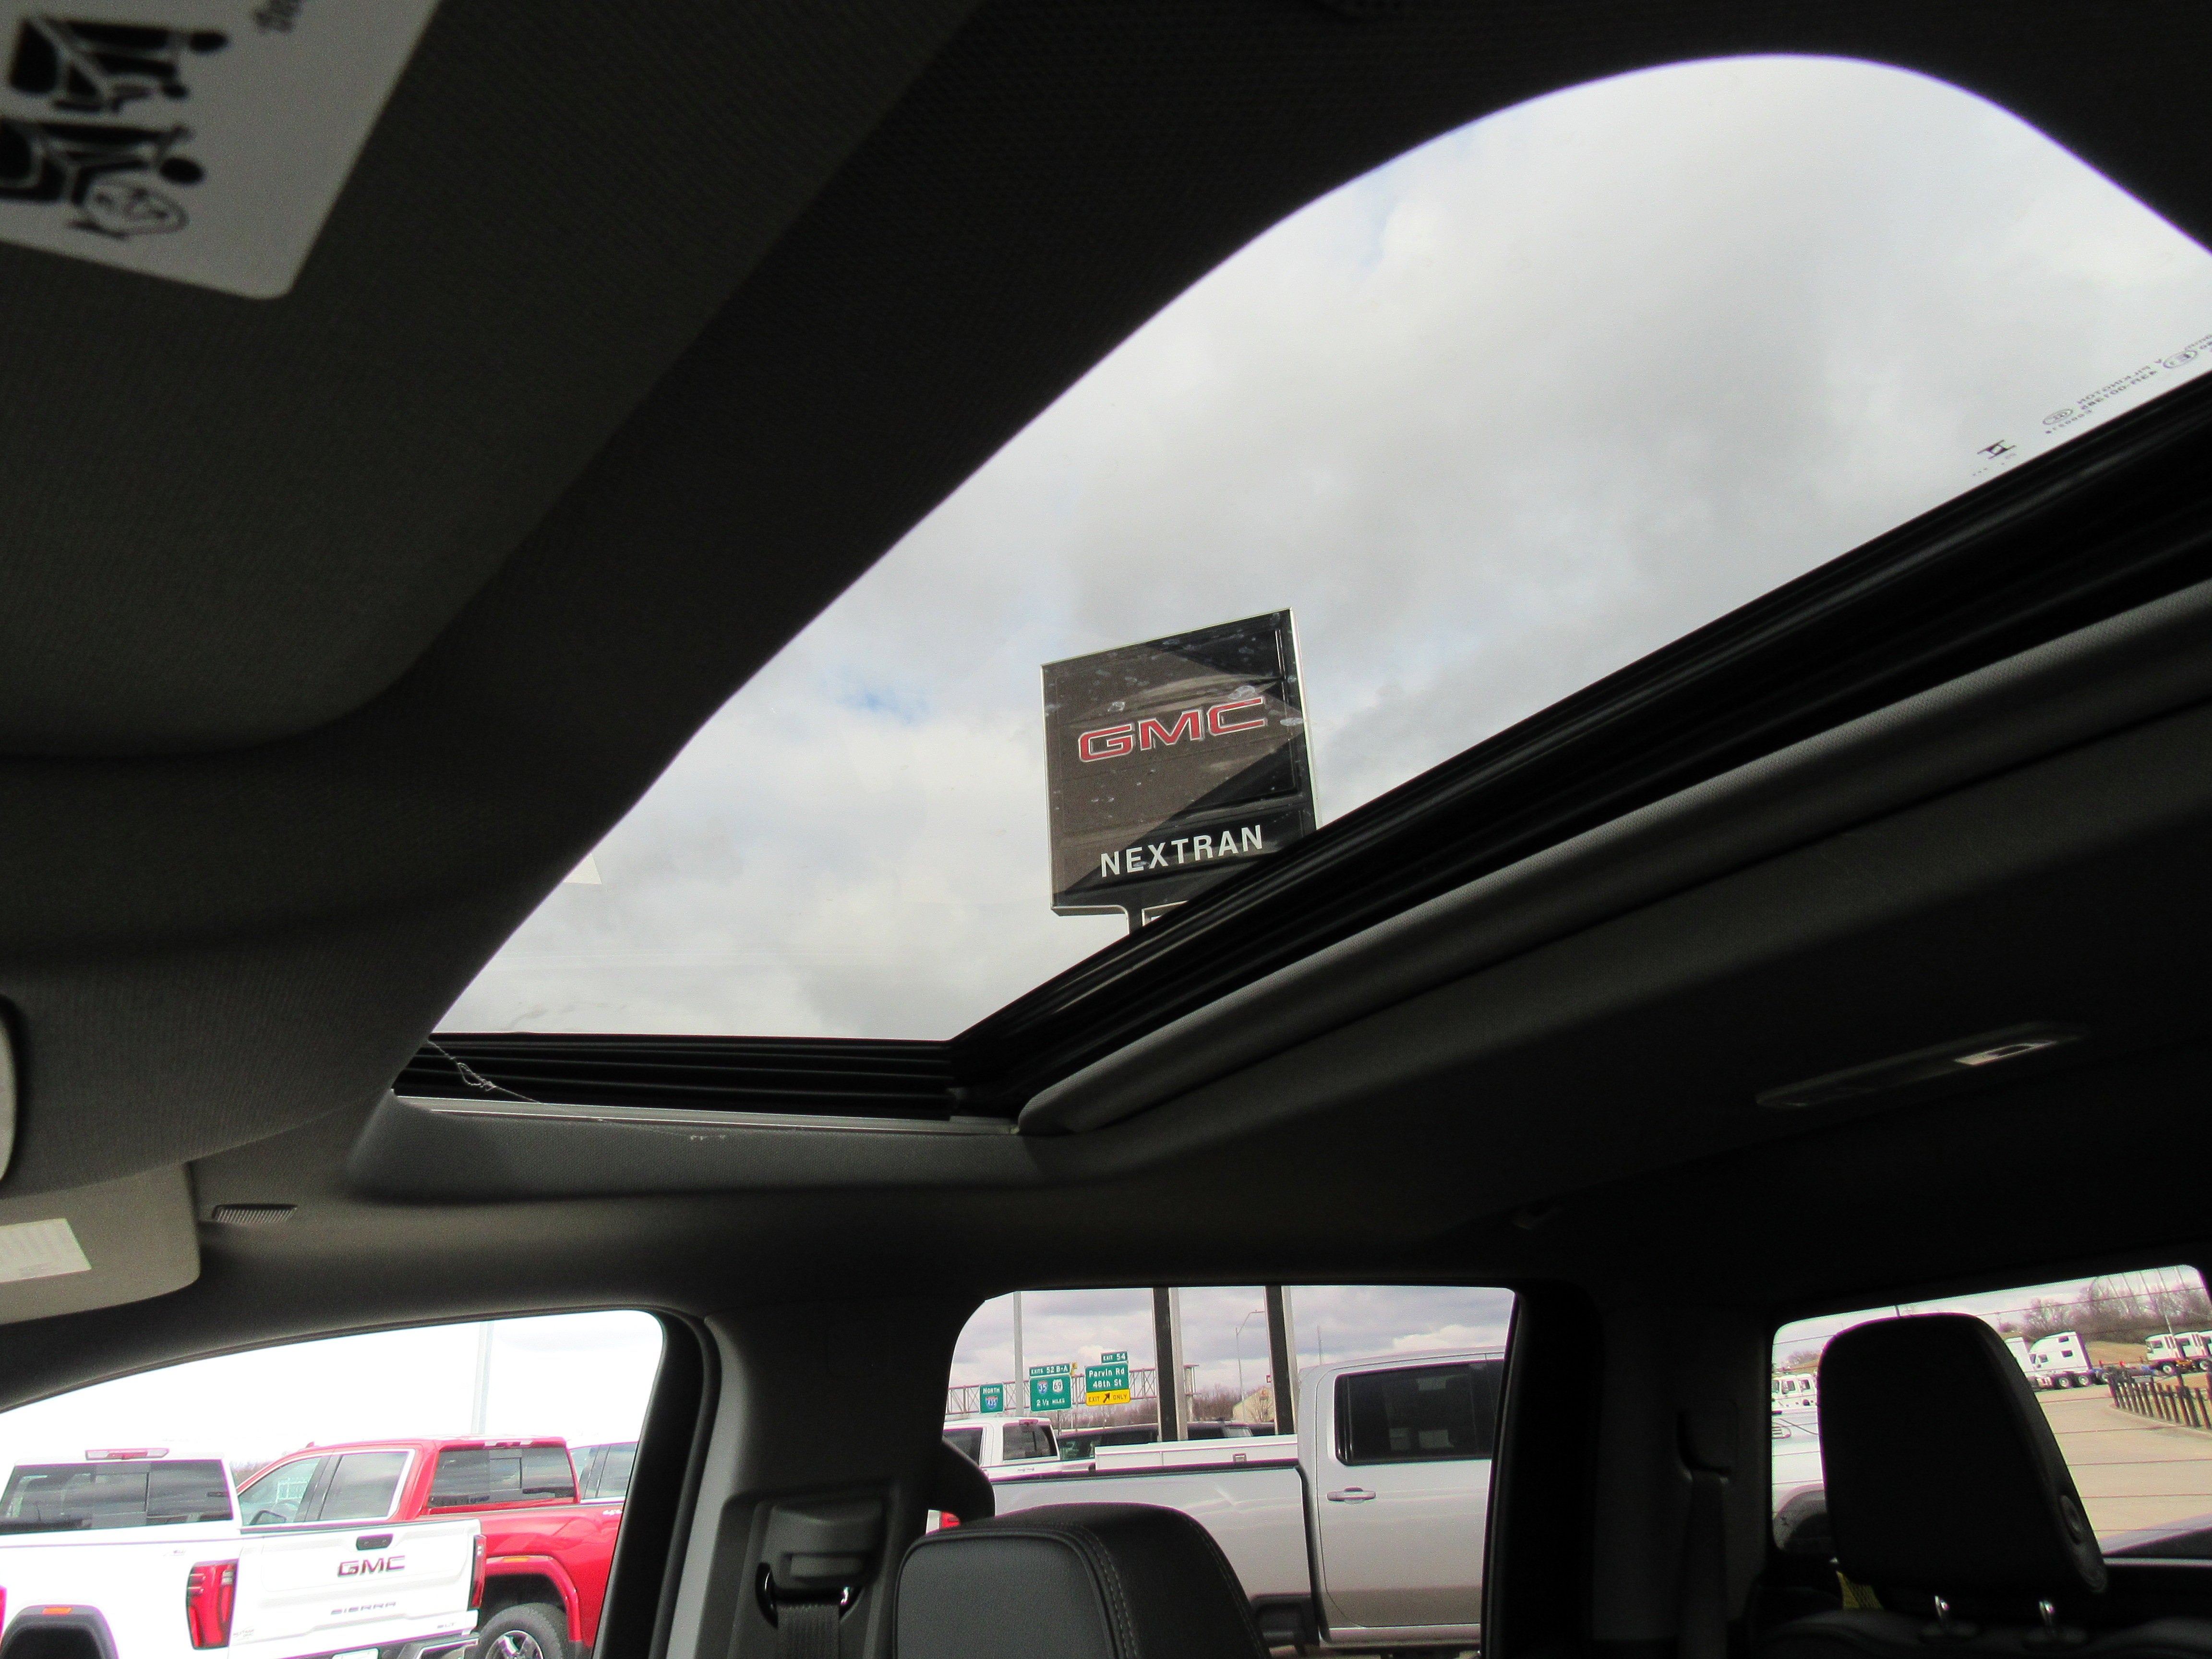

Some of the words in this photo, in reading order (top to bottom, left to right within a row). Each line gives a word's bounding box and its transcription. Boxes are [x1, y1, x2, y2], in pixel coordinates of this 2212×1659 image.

[1078, 696, 1268, 762] GMC
[1100, 824, 1263, 878] NEXTRAN
[1089, 1368, 1113, 1378] Parvin
[1115, 1367, 1125, 1375] Rd
[1039, 1383, 1047, 1391] 35
[1054, 1381, 1062, 1390] 69
[1092, 1380, 1111, 1388] 48th
[1114, 1378, 1122, 1387] St
[337, 1555, 406, 1577] GMC
[330, 1601, 397, 1615] SIERRA
